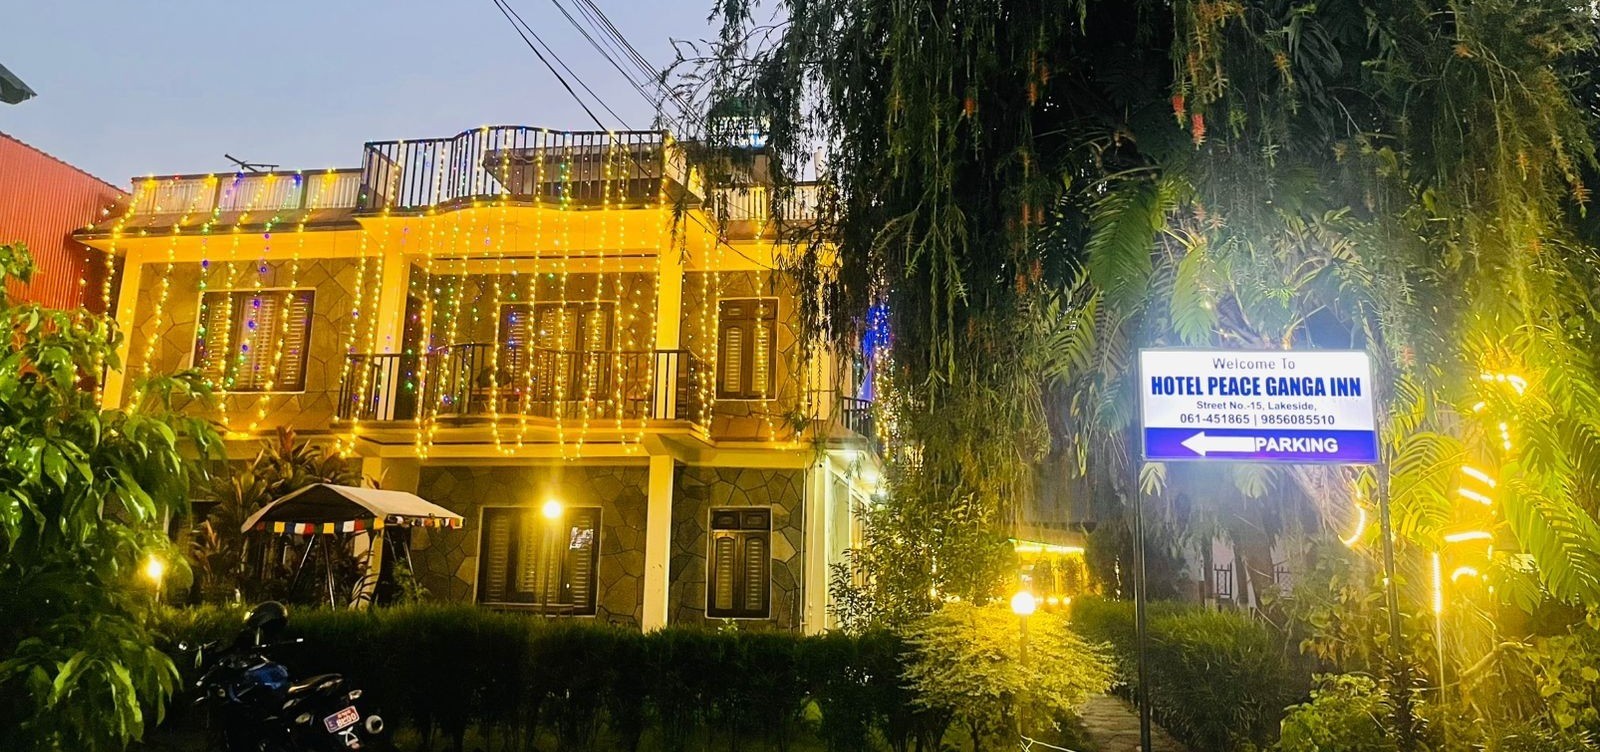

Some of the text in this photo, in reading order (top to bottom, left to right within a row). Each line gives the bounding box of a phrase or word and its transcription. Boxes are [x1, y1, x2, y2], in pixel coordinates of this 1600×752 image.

[1213, 358, 1295, 369] Welcome To
[1151, 376, 1361, 397] HOTEL PEACE GANGA INN
[1197, 401, 1226, 409] Street
[1268, 402, 1317, 411] Lakeside,
[1180, 414, 1249, 424] 061-451865
[1261, 415, 1335, 424] 9856085510
[1255, 437, 1338, 453] PARKING
